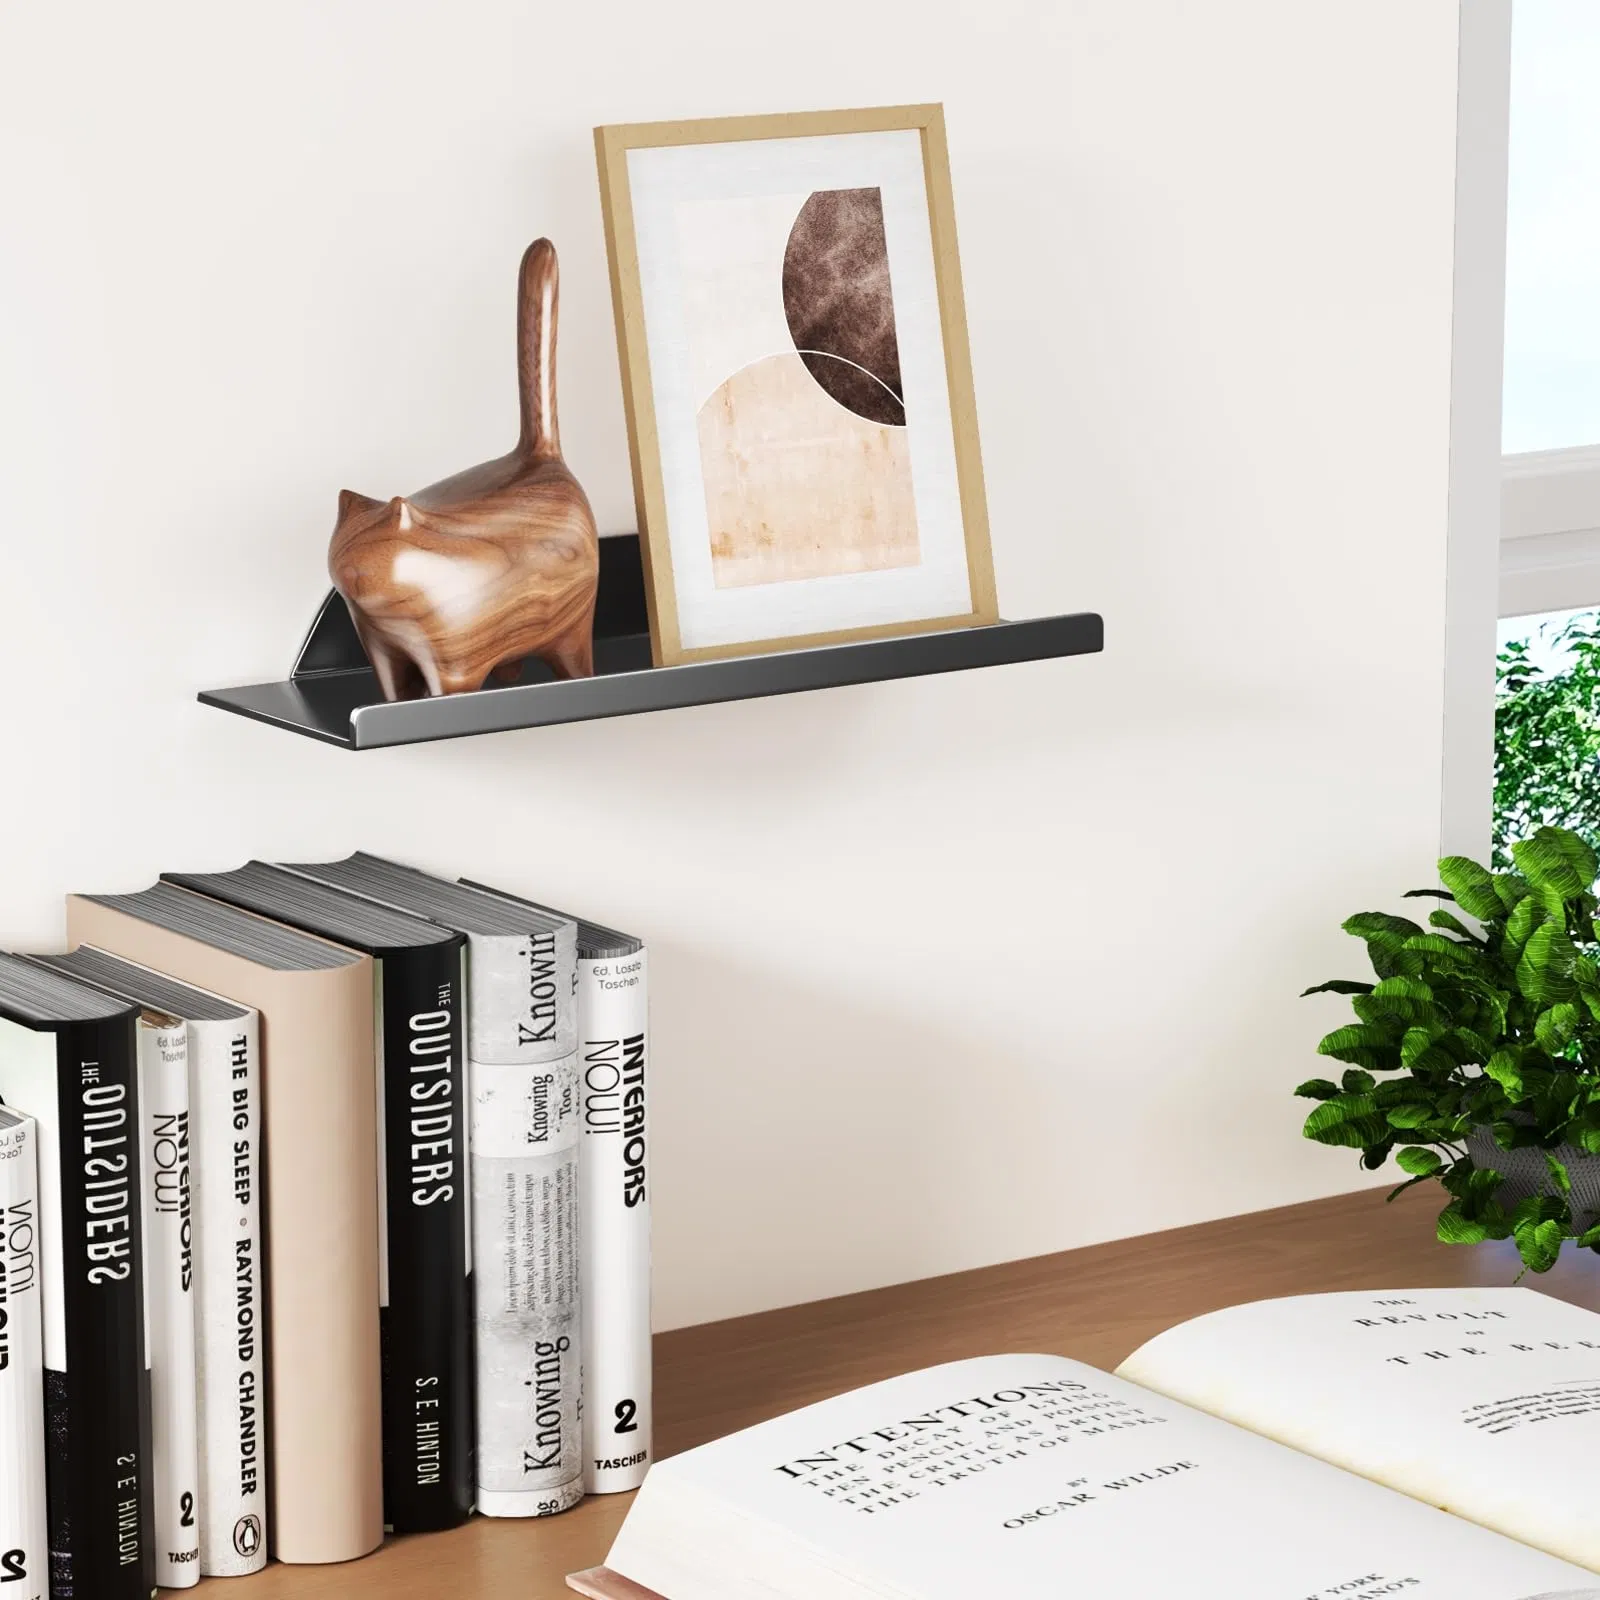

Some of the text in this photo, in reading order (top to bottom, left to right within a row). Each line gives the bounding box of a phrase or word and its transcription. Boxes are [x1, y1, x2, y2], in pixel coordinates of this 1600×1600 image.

[438, 982, 451, 1007] THE
[408, 1009, 454, 1208] OUTSIDERS
[527, 1073, 554, 1144] Knowing
[584, 1040, 621, 1135] NOW!
[622, 1033, 646, 1209] INTERIORS
[231, 1035, 257, 1498] THE BIG SLEEP RAYMOND CHANDLER
[1352, 1311, 1511, 1327] REVOLT
[1386, 1346, 1488, 1366] THE
[415, 1376, 440, 1485] S. E. HINTON
[522, 1335, 571, 1475] Knowing
[613, 1399, 638, 1435] 2
[773, 1379, 1088, 1478] INTENTIONS
[593, 1449, 648, 1471] TASCHEN
[801, 1463, 865, 1487] THE
[877, 1426, 962, 1459] DECAY
[979, 1410, 1011, 1423] OF
[822, 1400, 1127, 1497] PEN PENCIL AND POISON
[838, 1408, 1145, 1505] THE CRITIC AS ARTIST
[856, 1416, 1169, 1514] THE TRUTH OF MASKS
[180, 1491, 195, 1528] 2
[1002, 1460, 1200, 1530] OSCAR WILDE
[1324, 1572, 1385, 1595] YORK
